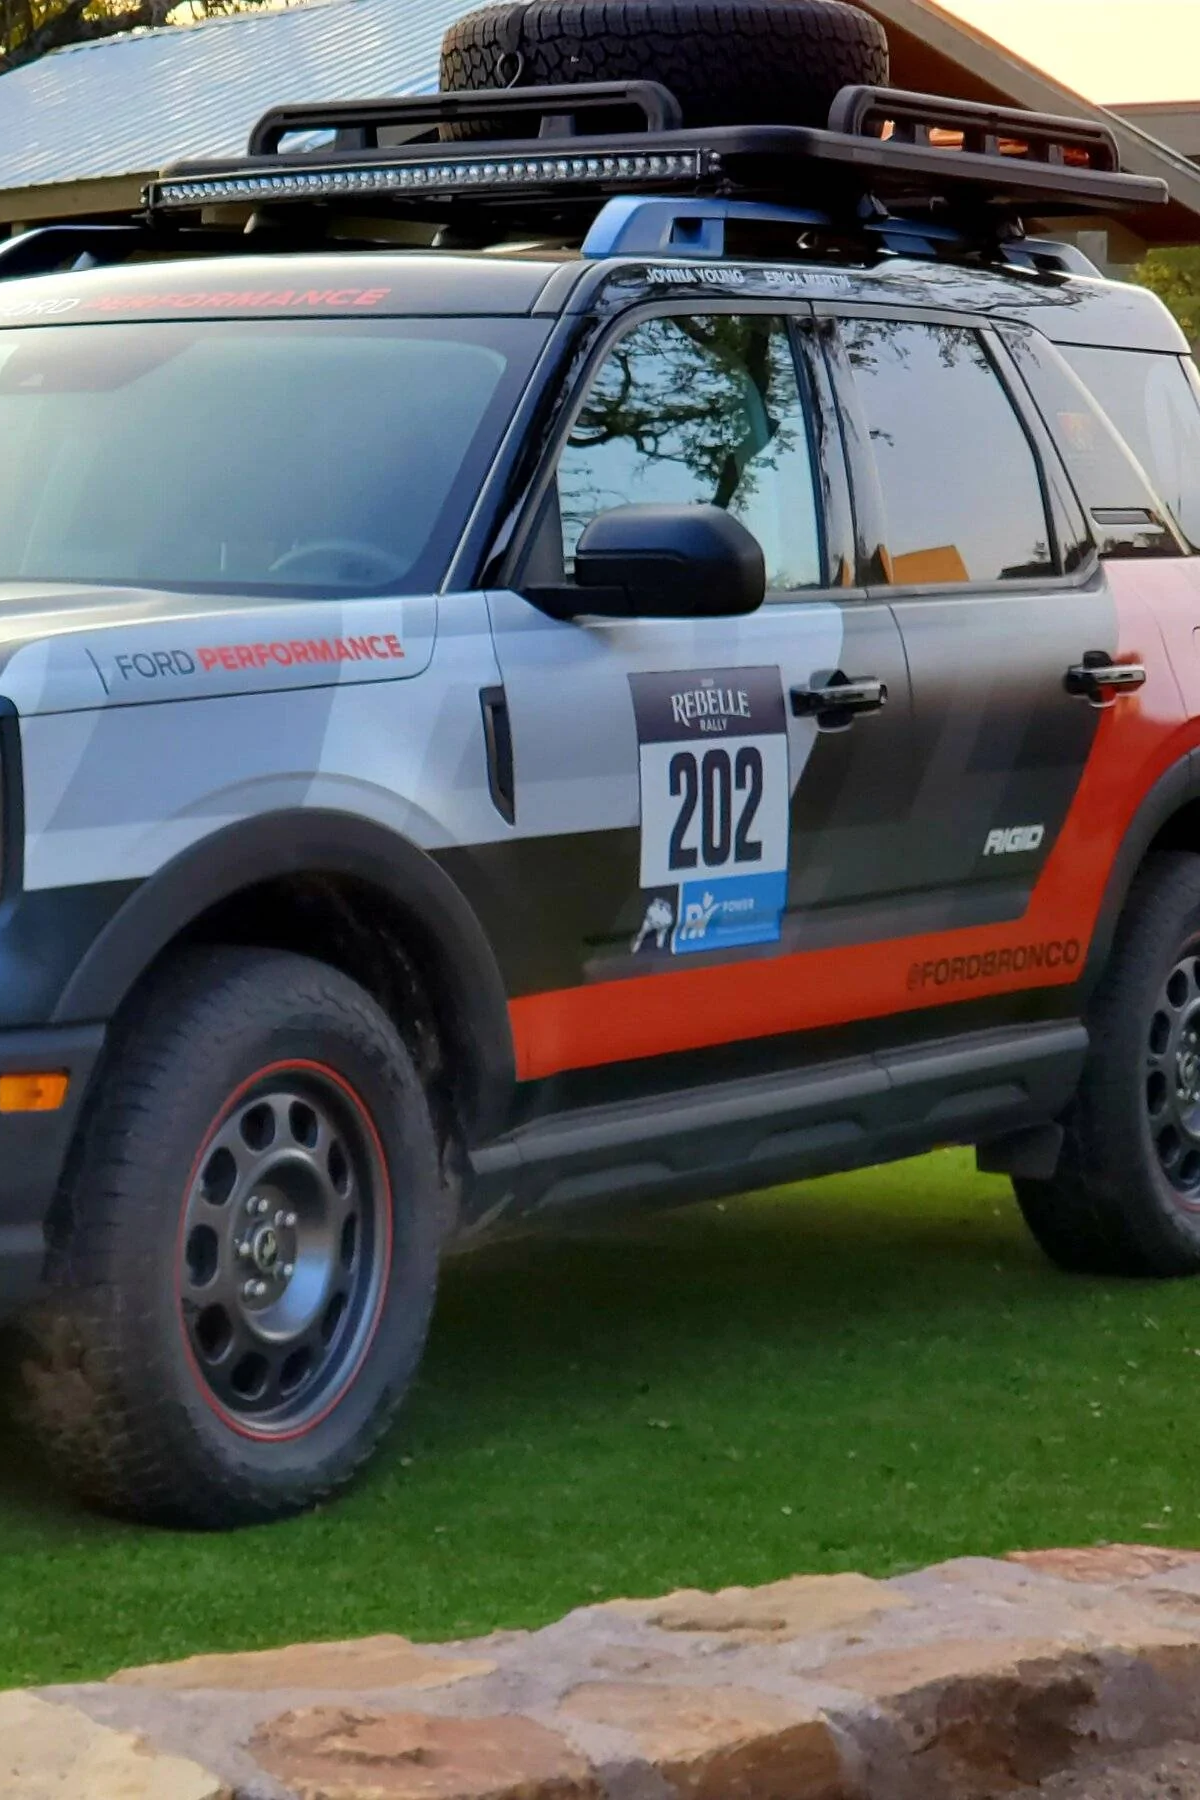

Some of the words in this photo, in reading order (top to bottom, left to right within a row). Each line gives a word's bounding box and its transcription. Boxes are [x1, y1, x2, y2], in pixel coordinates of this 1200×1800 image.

[696, 269, 745, 284] YOUNG
[77, 288, 392, 312] PERFORMANCE
[116, 649, 196, 681] FORD
[197, 634, 406, 672] PERFORMANCE
[670, 688, 751, 727] REBELLE
[668, 746, 763, 871] 202
[907, 938, 1080, 991] @FORDBRONCO
